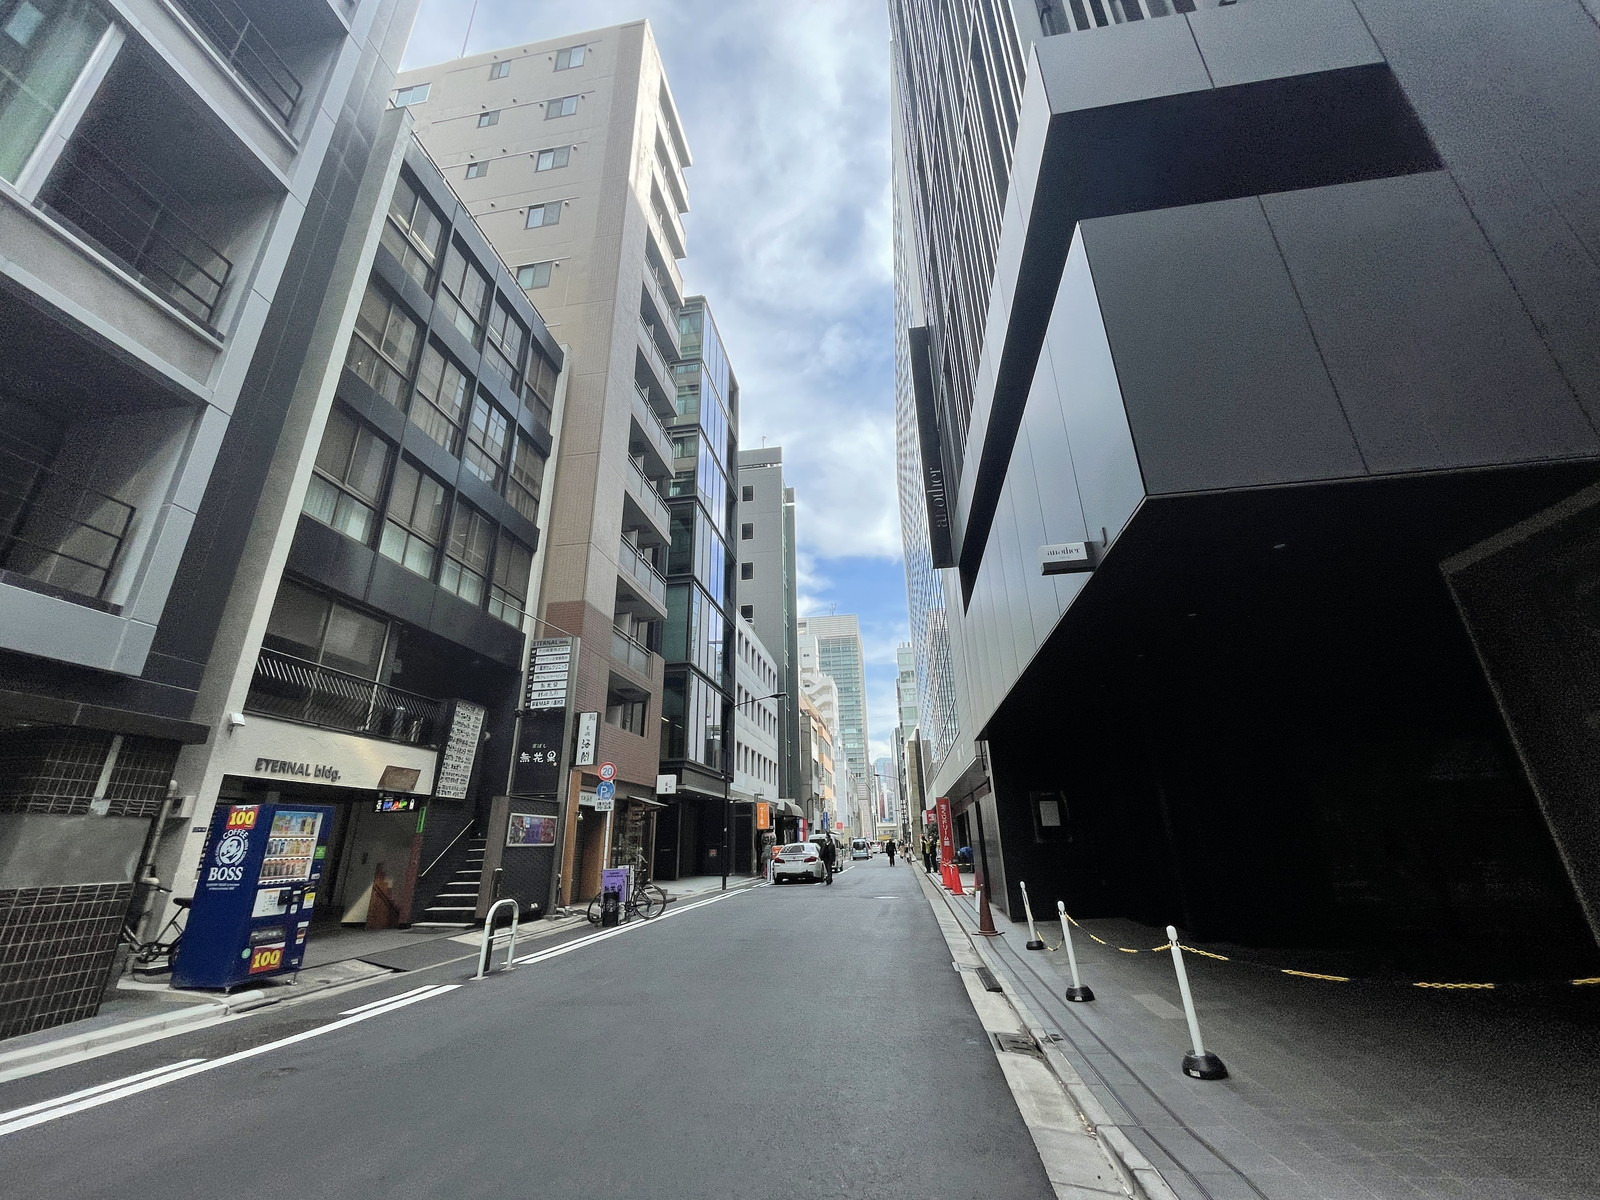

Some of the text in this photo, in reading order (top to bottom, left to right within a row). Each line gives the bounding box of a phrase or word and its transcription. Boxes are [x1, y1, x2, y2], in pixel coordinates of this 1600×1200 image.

[1047, 546, 1081, 556] another
[254, 757, 342, 782] ETERNAL bldg.
[602, 767, 613, 776] 20
[229, 810, 255, 826] 100
[222, 828, 249, 840] COFFEE
[207, 866, 243, 881] BOSS
[252, 949, 281, 969] 100
